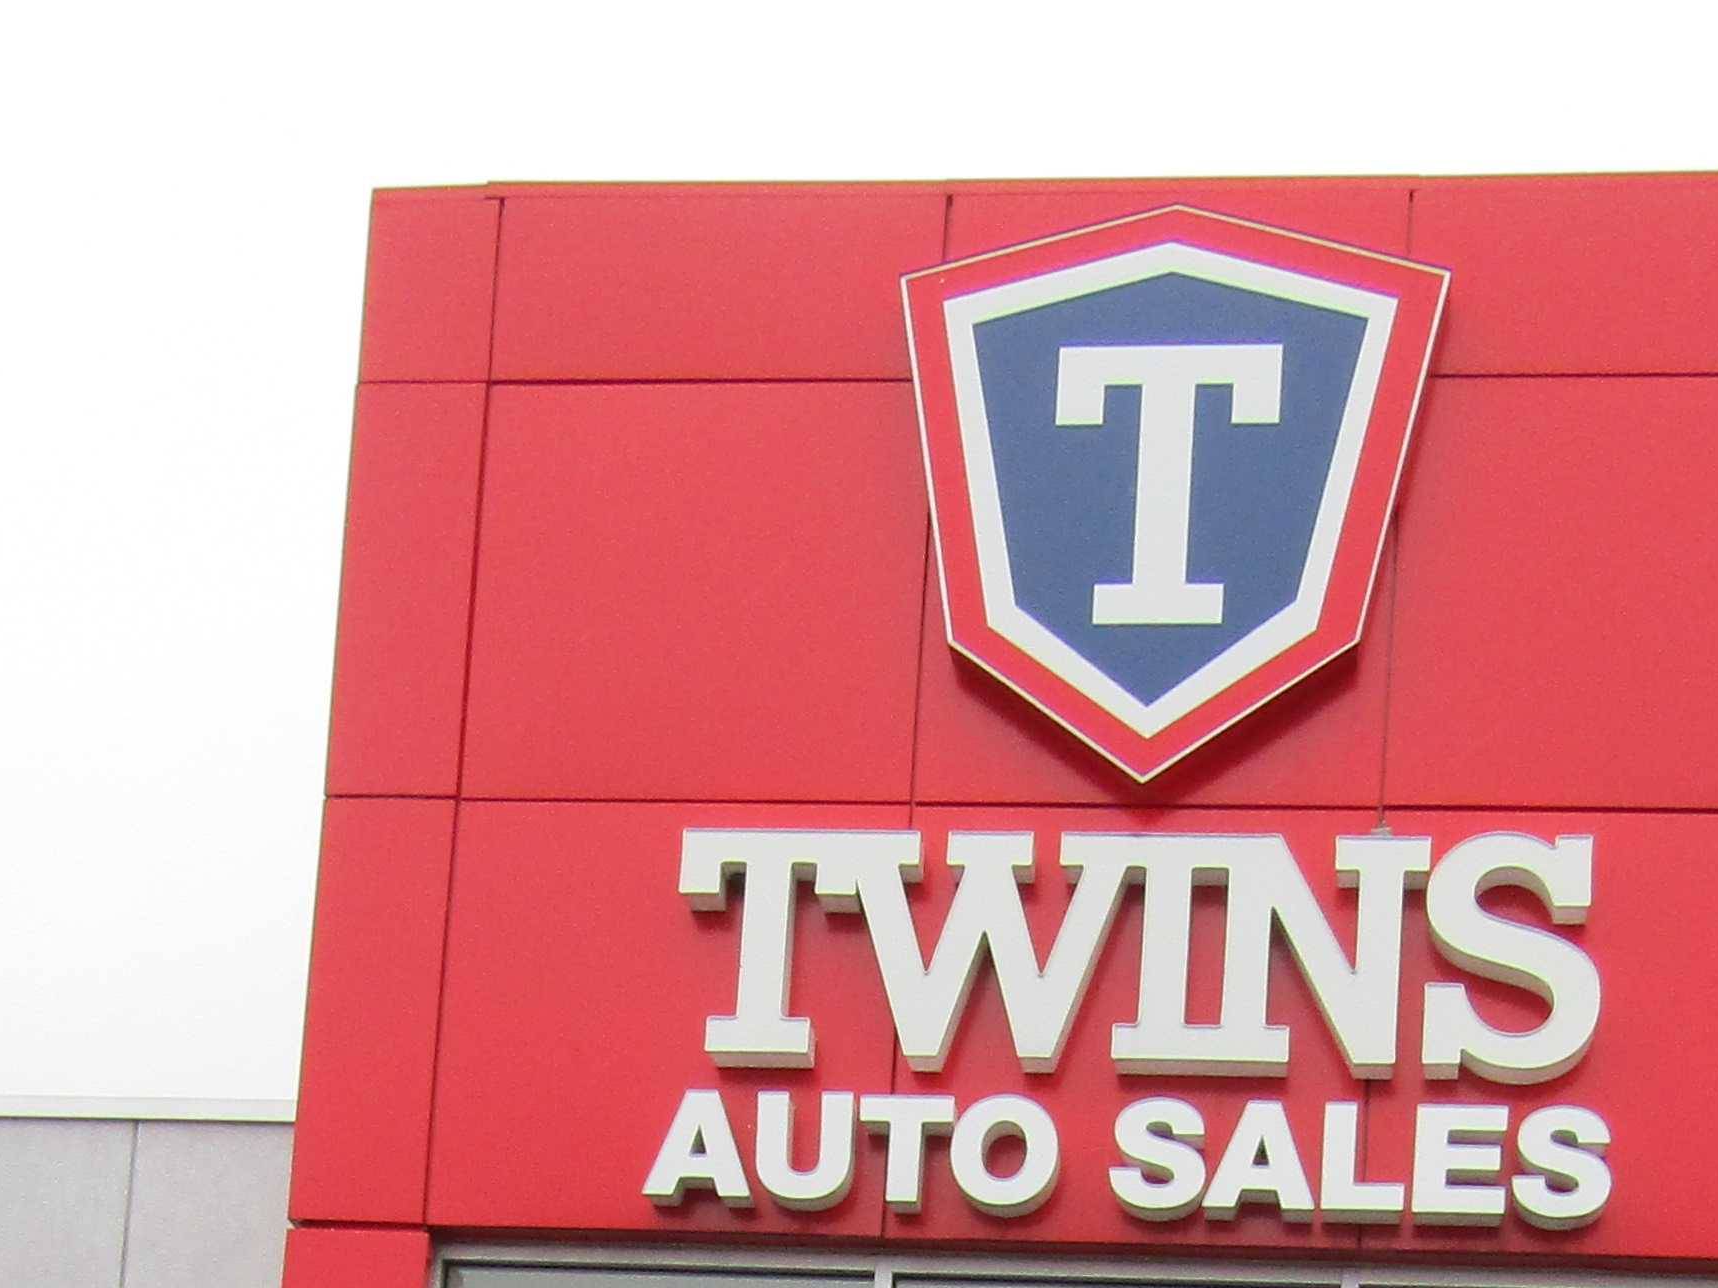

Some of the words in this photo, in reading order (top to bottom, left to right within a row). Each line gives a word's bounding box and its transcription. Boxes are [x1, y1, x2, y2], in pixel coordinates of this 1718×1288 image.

[1055, 344, 1284, 627] T
[680, 828, 1602, 1085] TWINS
[642, 1089, 1061, 1218] AUTO
[1109, 1096, 1612, 1231] SALES
